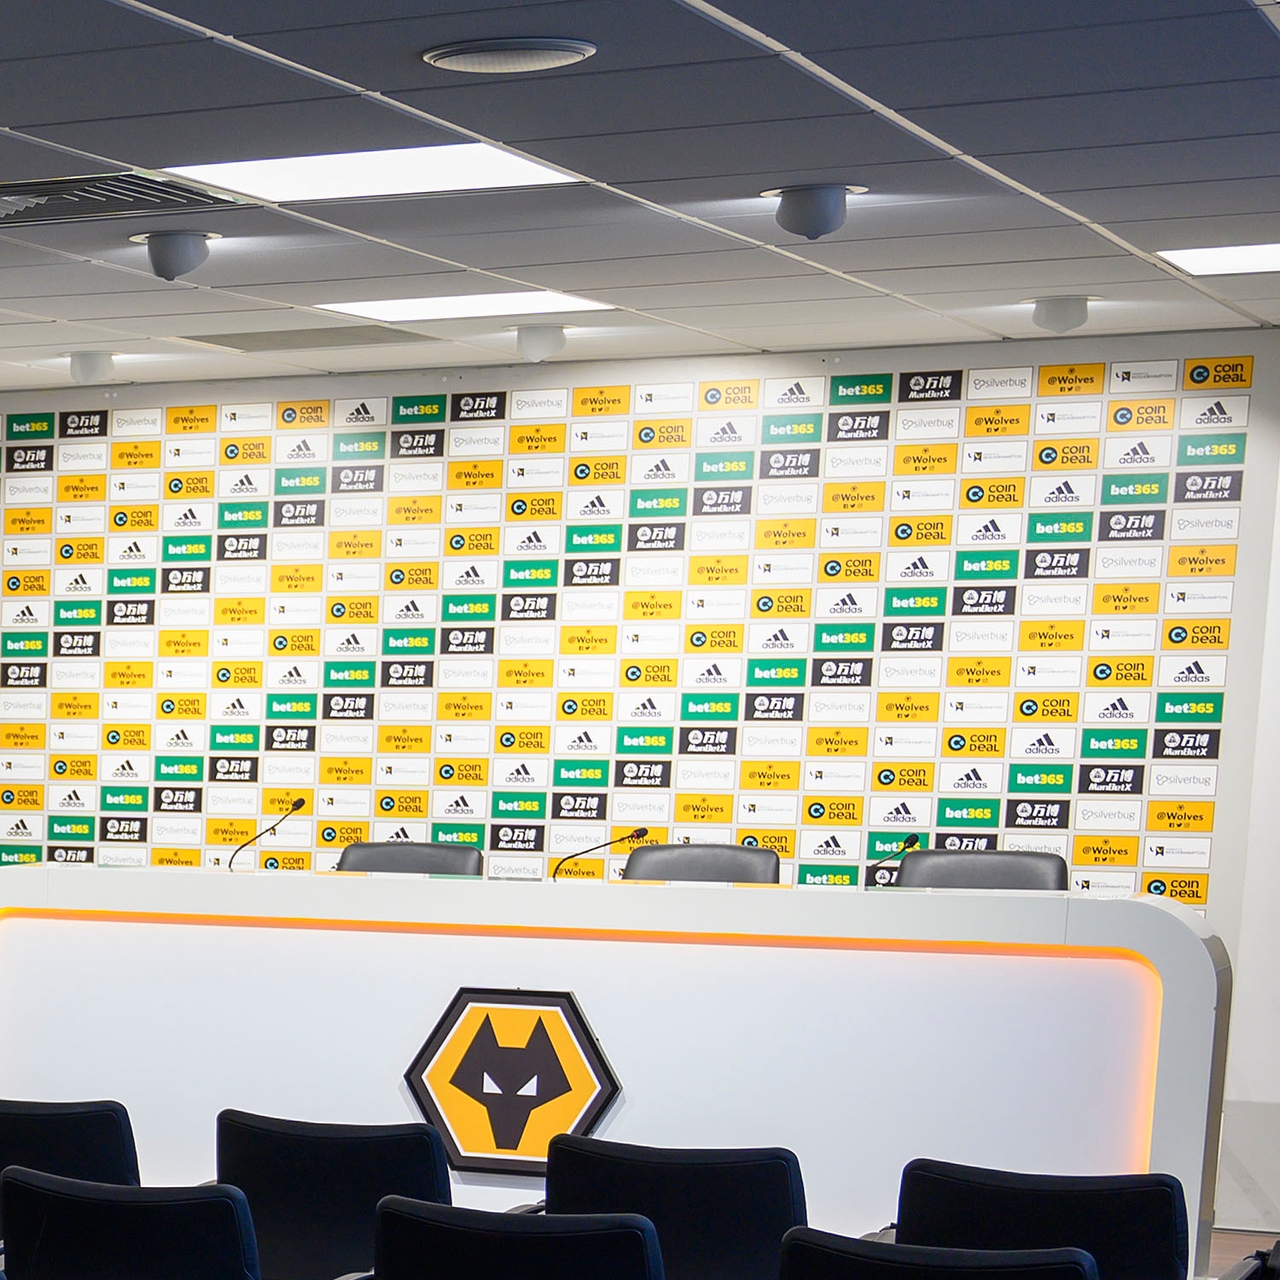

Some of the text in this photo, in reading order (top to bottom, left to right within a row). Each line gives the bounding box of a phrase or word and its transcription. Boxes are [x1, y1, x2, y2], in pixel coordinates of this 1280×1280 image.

[1047, 375, 1094, 386] @Wolves
[838, 383, 884, 397] bet365
[580, 397, 622, 406] @Wolves
[776, 395, 811, 405] adidas
[398, 404, 439, 416] bet365
[172, 415, 209, 425] @Wolves
[1195, 414, 1234, 425] adidas
[12, 421, 48, 433] bet365
[286, 450, 316, 459] adidas
[1186, 443, 1237, 457] bet365
[902, 454, 947, 464] @Wolves
[702, 460, 747, 473] bet365
[455, 470, 495, 479] @Wolves
[63, 484, 99, 493] @Wolves
[1043, 494, 1080, 503] adidas
[224, 510, 262, 521] bet365
[579, 507, 612, 516] adidas
[173, 519, 202, 528] adidas
[1035, 522, 1084, 534] bet365
[572, 533, 615, 545] bet365
[764, 529, 807, 539] @Wolves
[336, 540, 374, 549] @Wolves
[1178, 556, 1227, 566] @Wolves
[899, 569, 934, 578] adidas
[64, 585, 92, 593] adidas
[891, 596, 938, 608] bet365
[59, 608, 96, 619] bet365
[221, 607, 258, 616] @Wolves
[394, 611, 425, 620] adidas
[568, 635, 609, 644] @Wolves
[1028, 631, 1074, 641] @Wolves
[6, 640, 42, 651] bet365
[388, 636, 429, 648] bet365
[695, 675, 728, 684] adidas
[1173, 674, 1211, 683] adidas
[57, 702, 92, 710] @Wolves
[444, 702, 484, 711] @Wolves
[688, 701, 732, 713] bet365
[1164, 702, 1215, 714] bet365
[221, 709, 250, 717] adidas
[215, 732, 254, 744] bet365
[816, 737, 860, 746] @Wolves
[566, 743, 598, 751] adidas
[111, 770, 139, 778] adidas
[326, 766, 364, 775] @Wolves
[952, 780, 988, 790] adidas
[444, 807, 475, 815] adidas
[498, 800, 540, 812] bet365
[683, 804, 725, 813] @Wolves
[944, 807, 991, 820] bet365
[6, 829, 33, 838] adidas
[53, 823, 89, 834] bet365
[813, 848, 848, 857] adidas
[1082, 846, 1129, 856] @Wolves
[806, 873, 851, 886] bet365
